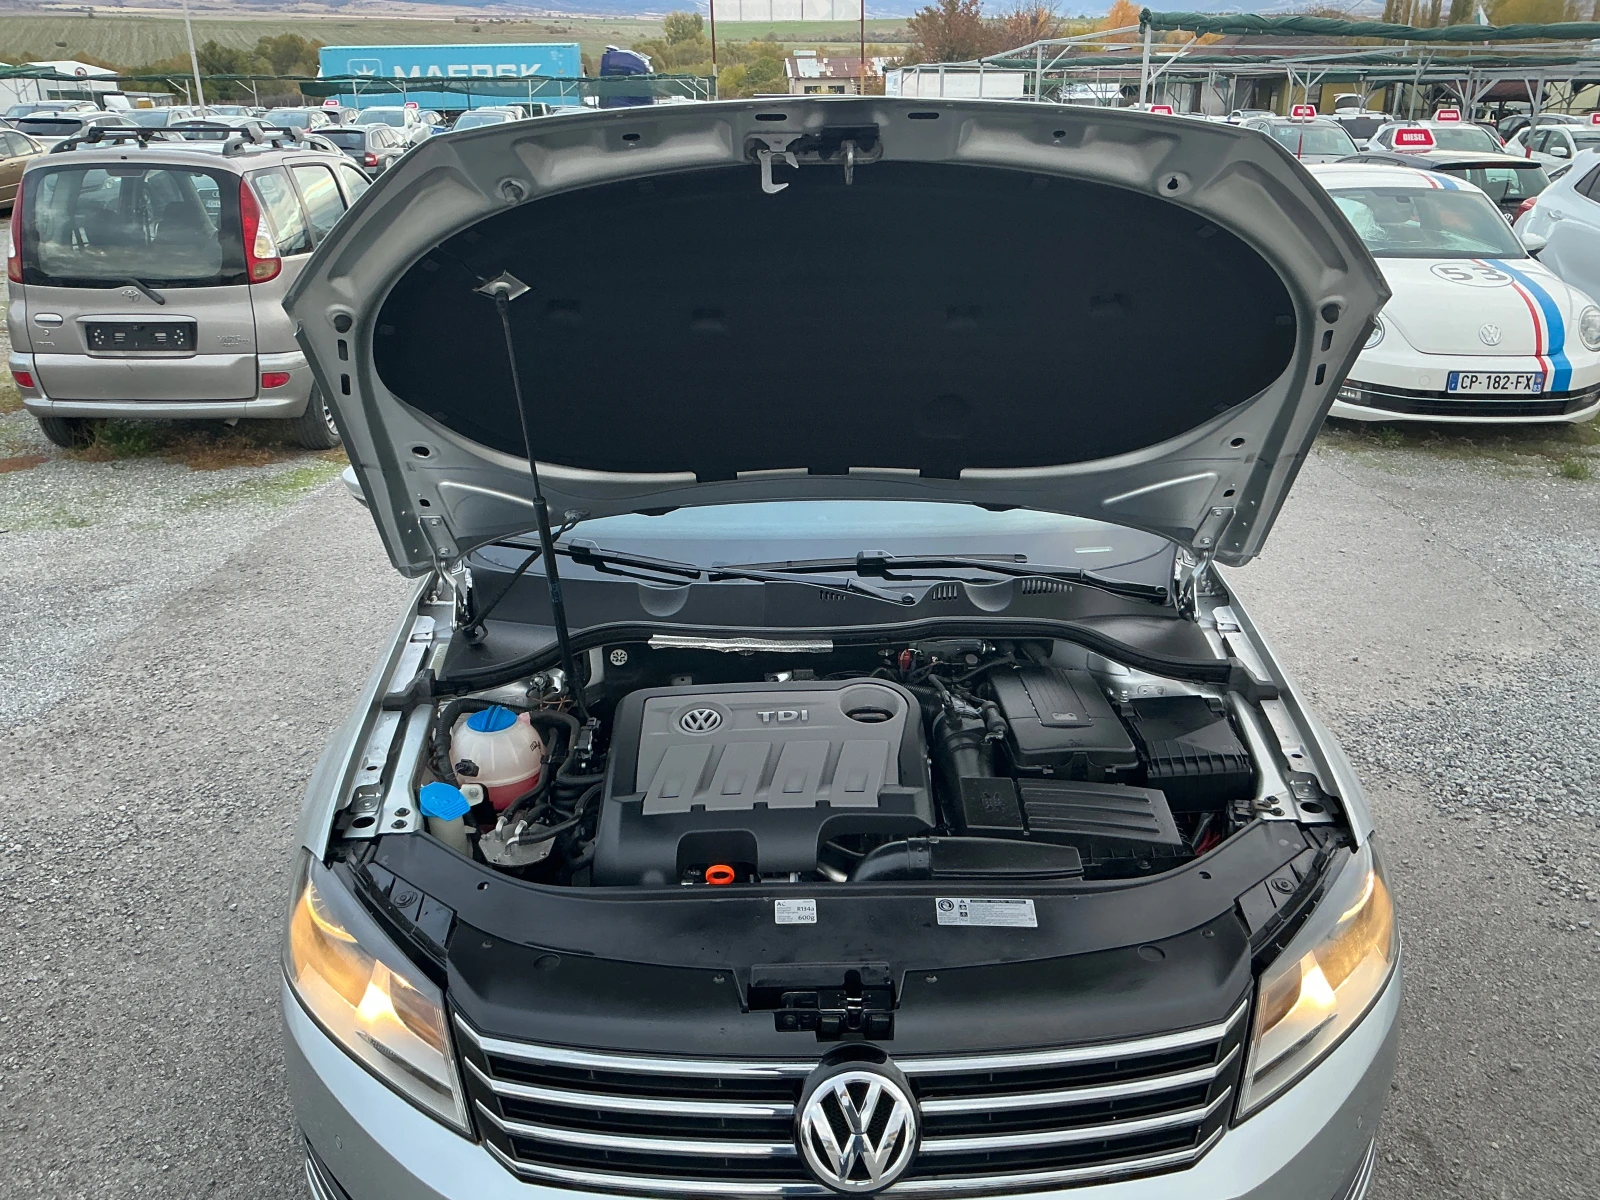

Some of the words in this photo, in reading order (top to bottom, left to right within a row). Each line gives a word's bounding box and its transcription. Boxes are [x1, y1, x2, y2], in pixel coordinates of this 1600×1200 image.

[1402, 133, 1426, 142] DIESEL
[1438, 267, 1508, 281] 53
[1460, 374, 1534, 390] CP-182-FX
[680, 708, 722, 733] VW
[757, 709, 808, 723] TDI
[801, 1071, 917, 1193] VW
